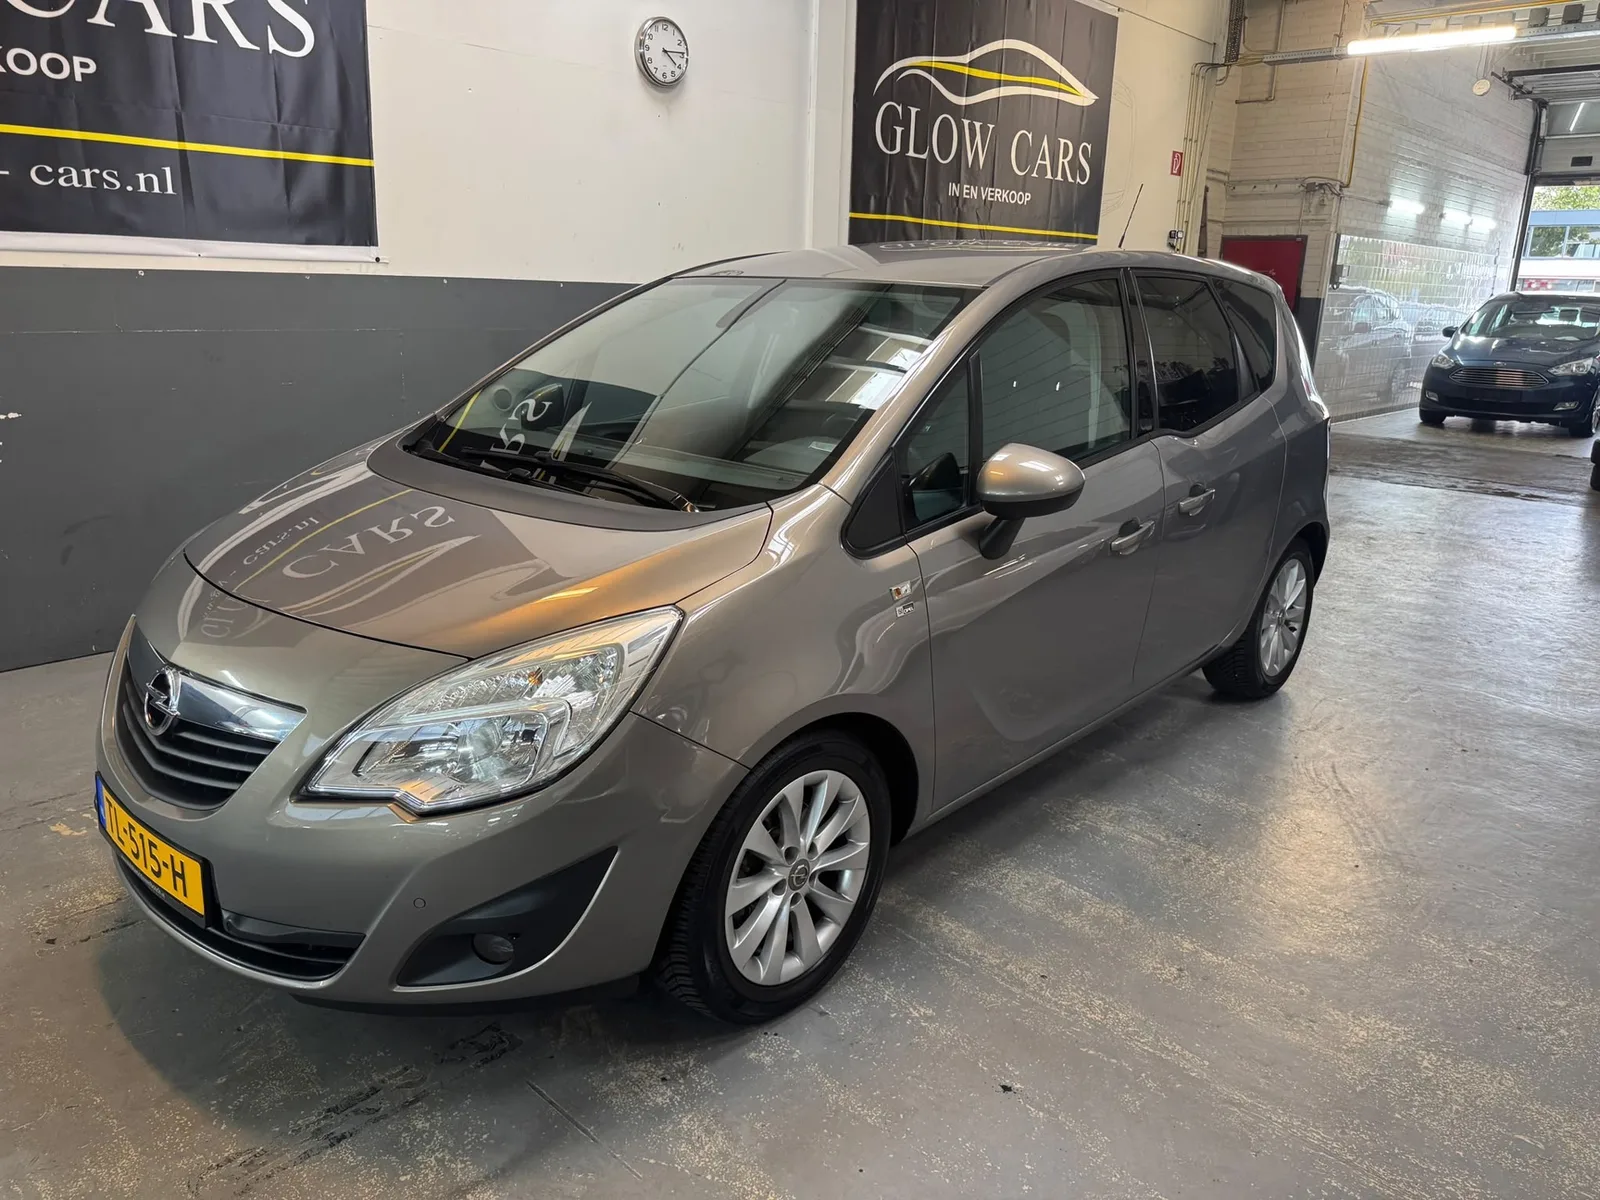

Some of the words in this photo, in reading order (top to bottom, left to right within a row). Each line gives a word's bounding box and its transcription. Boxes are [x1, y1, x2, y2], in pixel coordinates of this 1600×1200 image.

[5, 0, 315, 58] RS
[662, 23, 668, 31] 12
[0, 46, 97, 82] OOP
[875, 101, 995, 170] GLOW
[1010, 129, 1092, 185] CARS
[29, 163, 177, 195] cars.nl
[948, 182, 960, 196] IN
[963, 184, 978, 199] EN
[981, 187, 1032, 206] VERKOOP
[105, 796, 188, 899] TL-515-H
